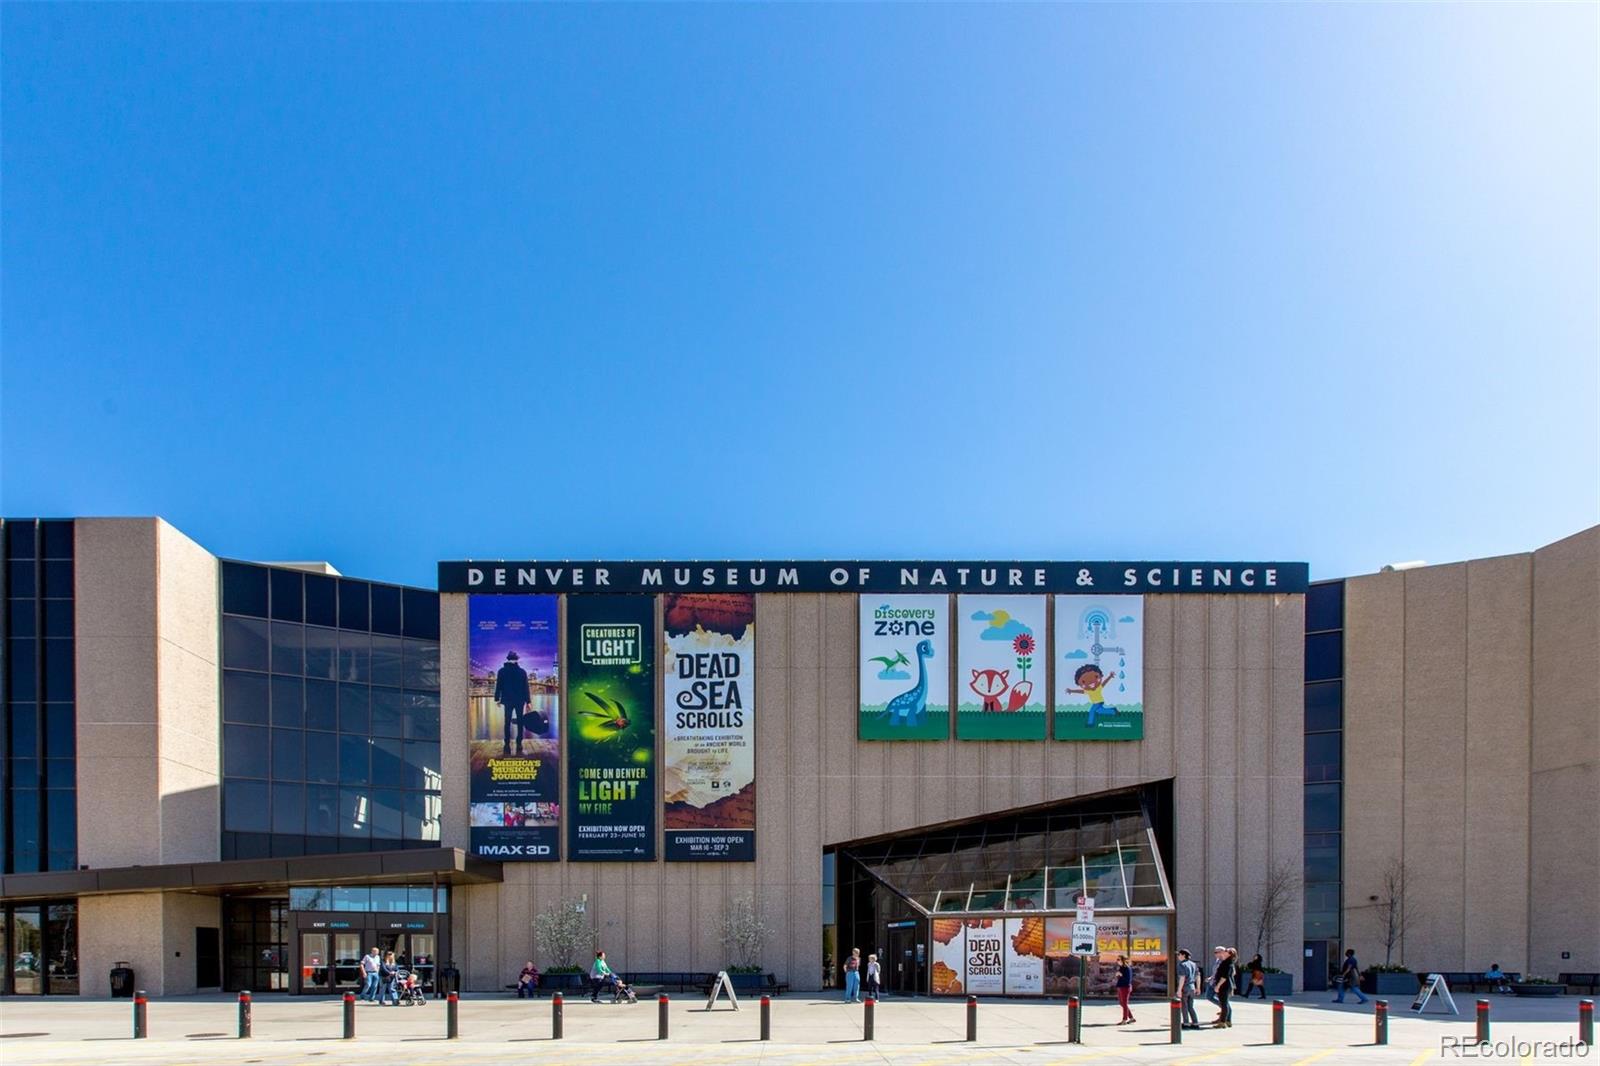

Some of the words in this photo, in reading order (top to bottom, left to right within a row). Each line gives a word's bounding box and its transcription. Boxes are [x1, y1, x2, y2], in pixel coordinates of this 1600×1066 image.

[467, 568, 610, 586] DENVER
[641, 568, 799, 586] MUSEUM
[829, 567, 870, 586] OF
[901, 568, 1046, 586] NATURE
[1075, 568, 1094, 586] &
[1123, 568, 1277, 586] SCIENCE
[586, 628, 625, 638] CREATURES
[627, 628, 636, 638] OF
[586, 640, 635, 656] LIGHT
[676, 652, 740, 679] DEAD
[676, 681, 742, 710] SEA
[676, 711, 743, 729] SCROLLS
[579, 768, 600, 779] COME
[603, 768, 614, 779] ON
[579, 780, 639, 800] LIGHT
[579, 803, 592, 815] MY
[594, 803, 612, 815] FIRE
[479, 845, 522, 854] IMAX
[526, 845, 550, 854] 3D
[969, 939, 1000, 952] DEAD
[1051, 938, 1161, 951] JESALEM
[969, 953, 1001, 967] SEA
[969, 967, 1002, 975] SCROLLS
